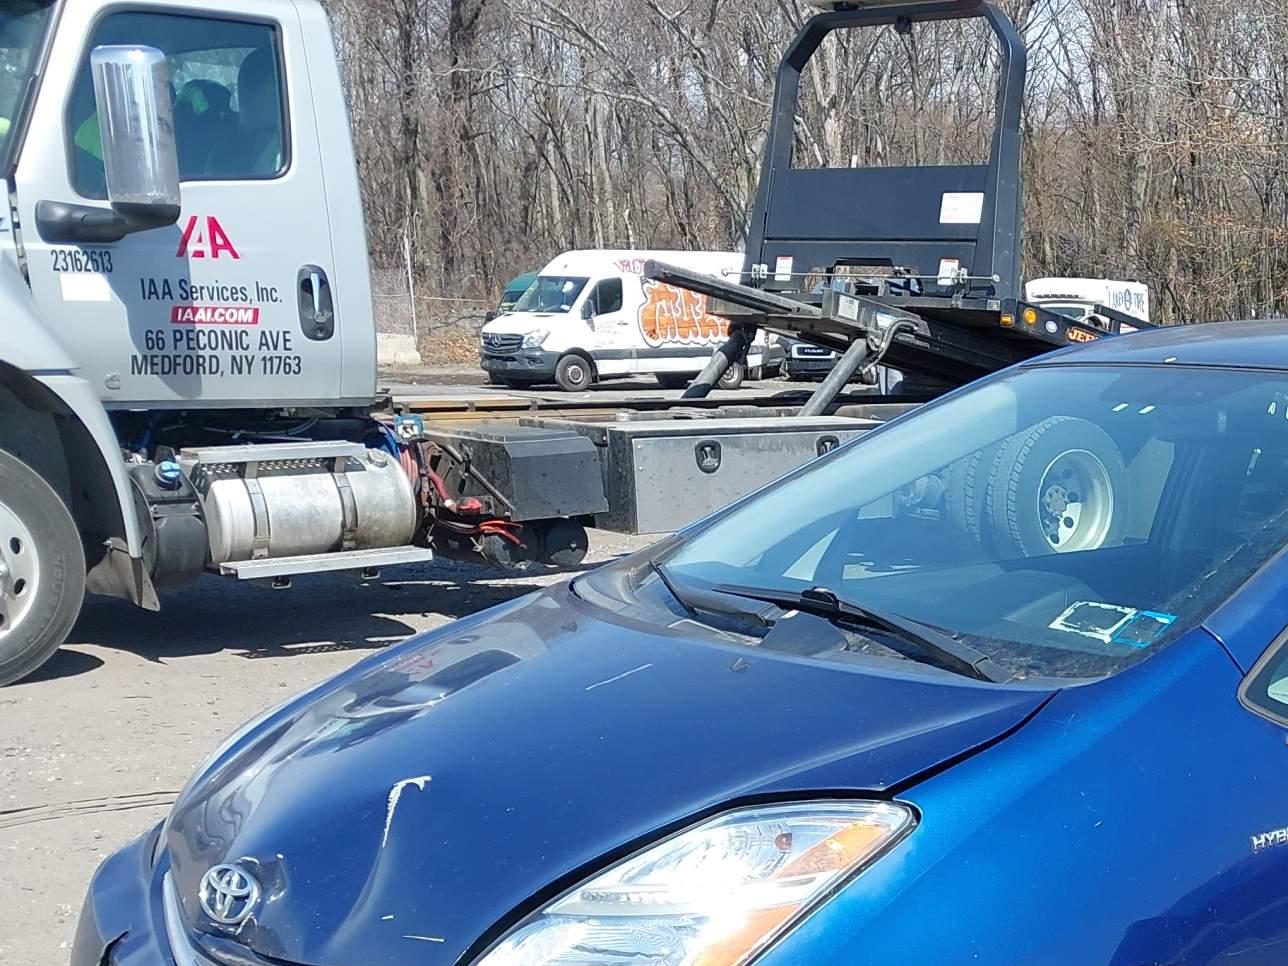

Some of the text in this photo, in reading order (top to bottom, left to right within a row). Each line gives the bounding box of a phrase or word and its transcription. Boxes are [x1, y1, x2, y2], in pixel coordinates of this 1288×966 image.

[50, 249, 113, 273] 23162613
[140, 278, 283, 305] IAA Services, Inc.
[177, 309, 254, 324] IAAI.COM
[145, 330, 292, 351] 66 PECONIC AVE
[130, 355, 302, 378] MEDFORD, NY 11763
